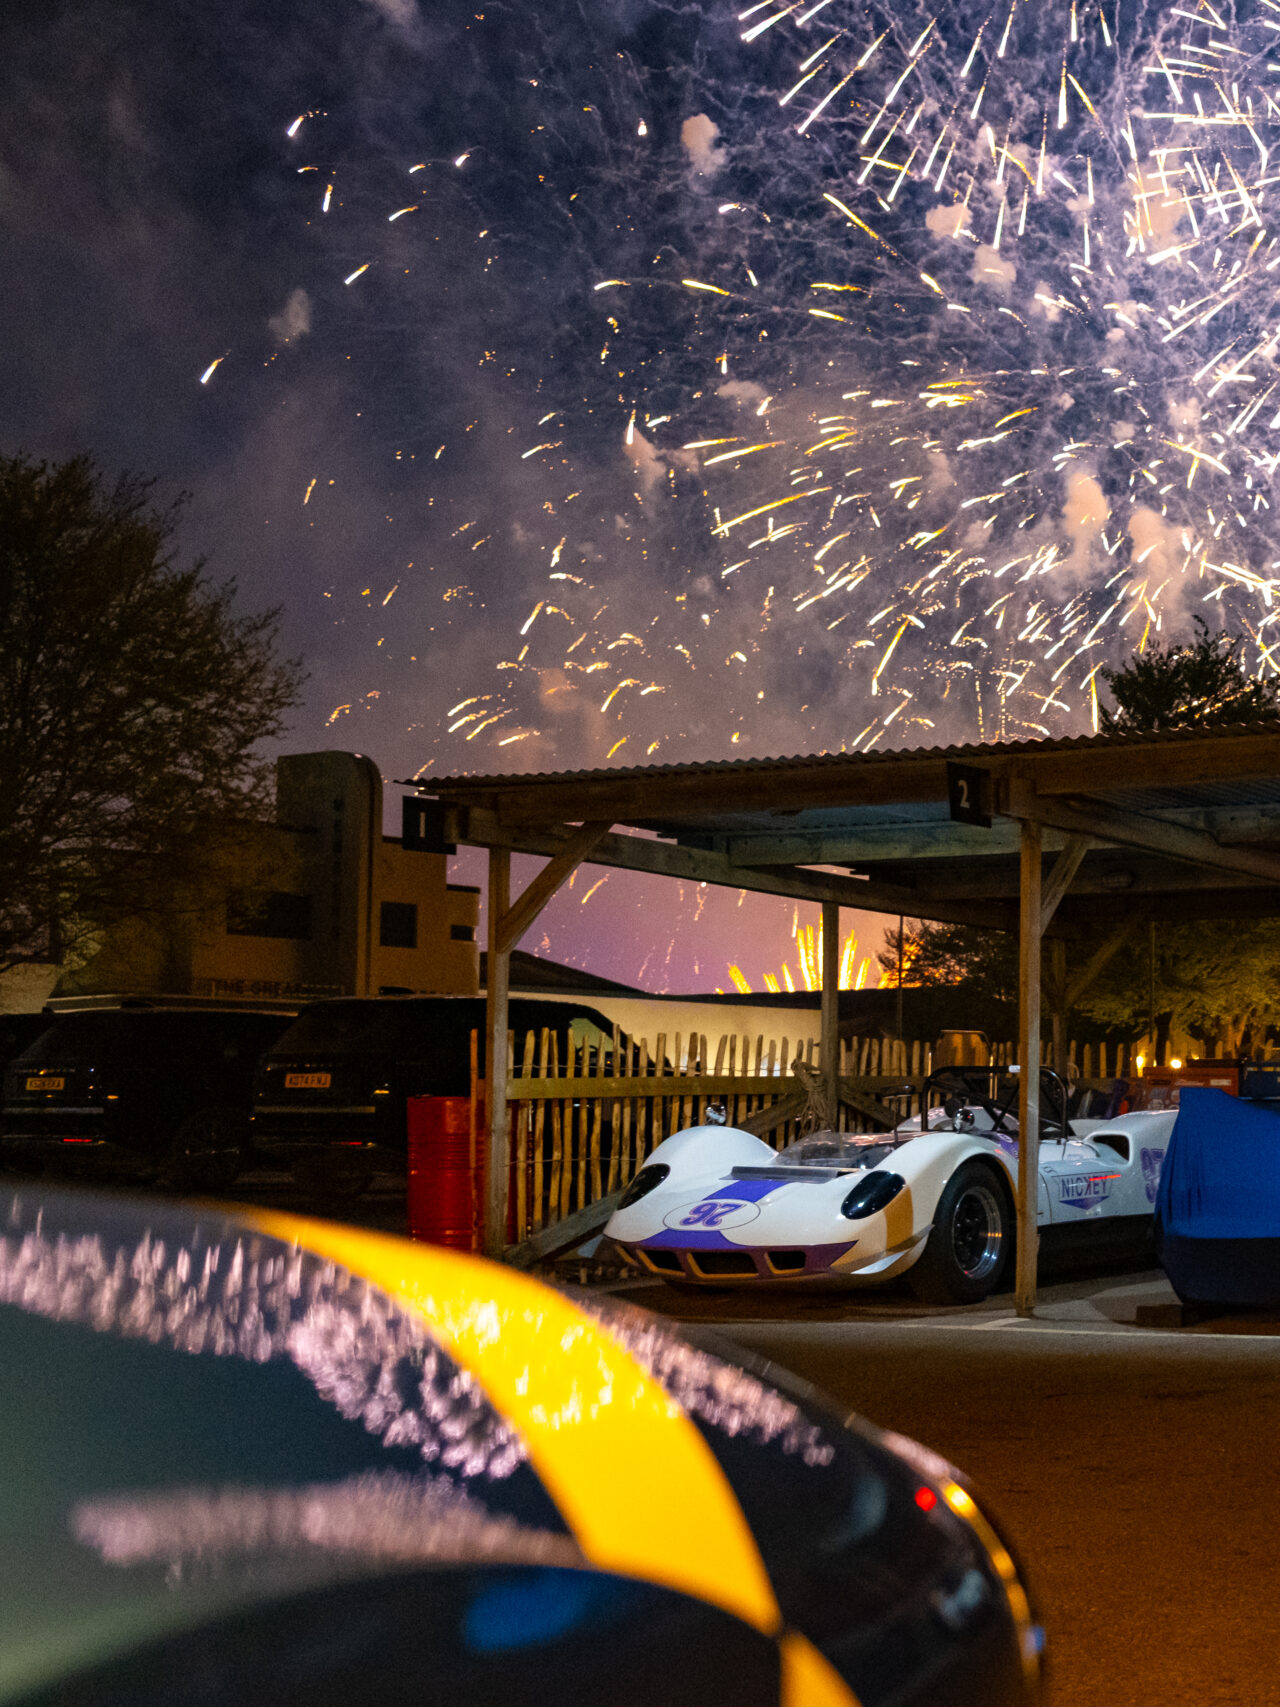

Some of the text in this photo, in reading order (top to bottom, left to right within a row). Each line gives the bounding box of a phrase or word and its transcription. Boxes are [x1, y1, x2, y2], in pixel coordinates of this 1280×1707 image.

[957, 779, 970, 809] 2
[418, 811, 426, 838] 1
[1061, 1174, 1107, 1198] NICKEY
[680, 1202, 747, 1227] 97
